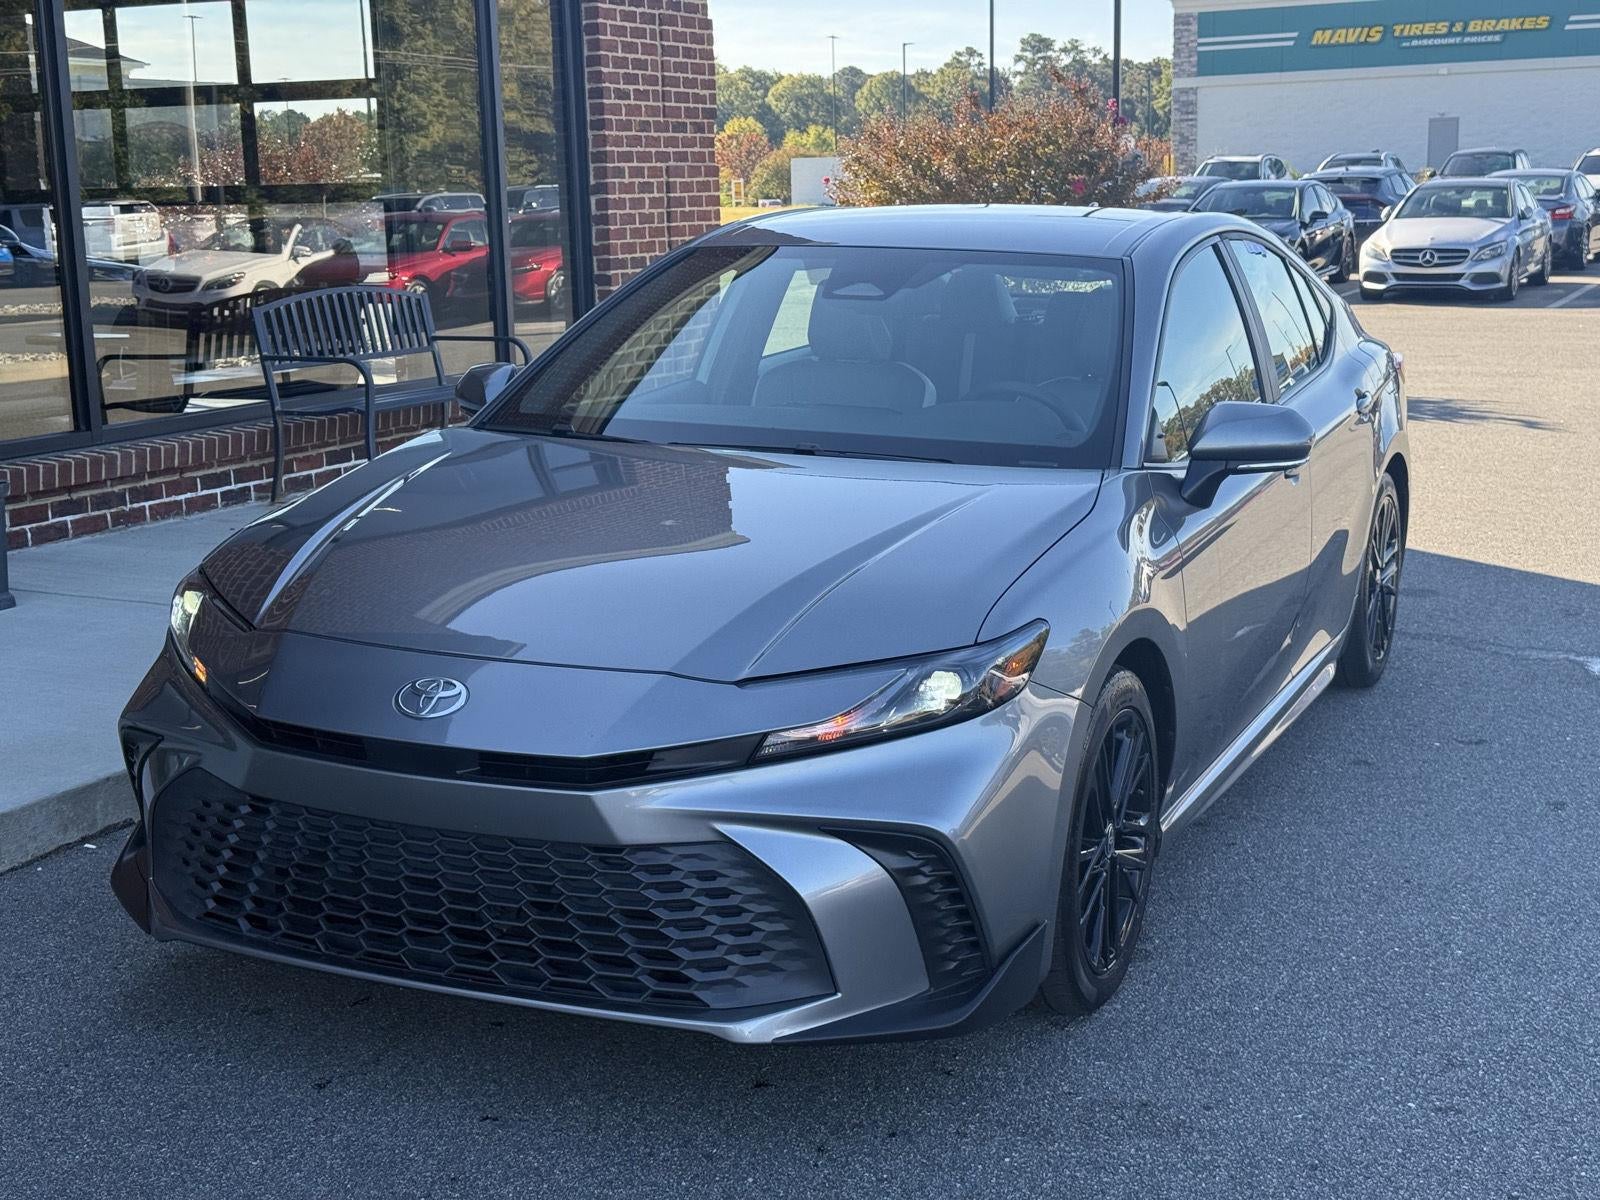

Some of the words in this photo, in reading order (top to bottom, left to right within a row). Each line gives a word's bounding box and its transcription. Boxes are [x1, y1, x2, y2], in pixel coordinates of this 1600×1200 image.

[1310, 26, 1384, 46] MAVIS
[1392, 22, 1449, 36] TIRES
[1452, 21, 1465, 33] &
[1466, 15, 1551, 33] BRAKES
[1411, 37, 1463, 46] DISCOUNT
